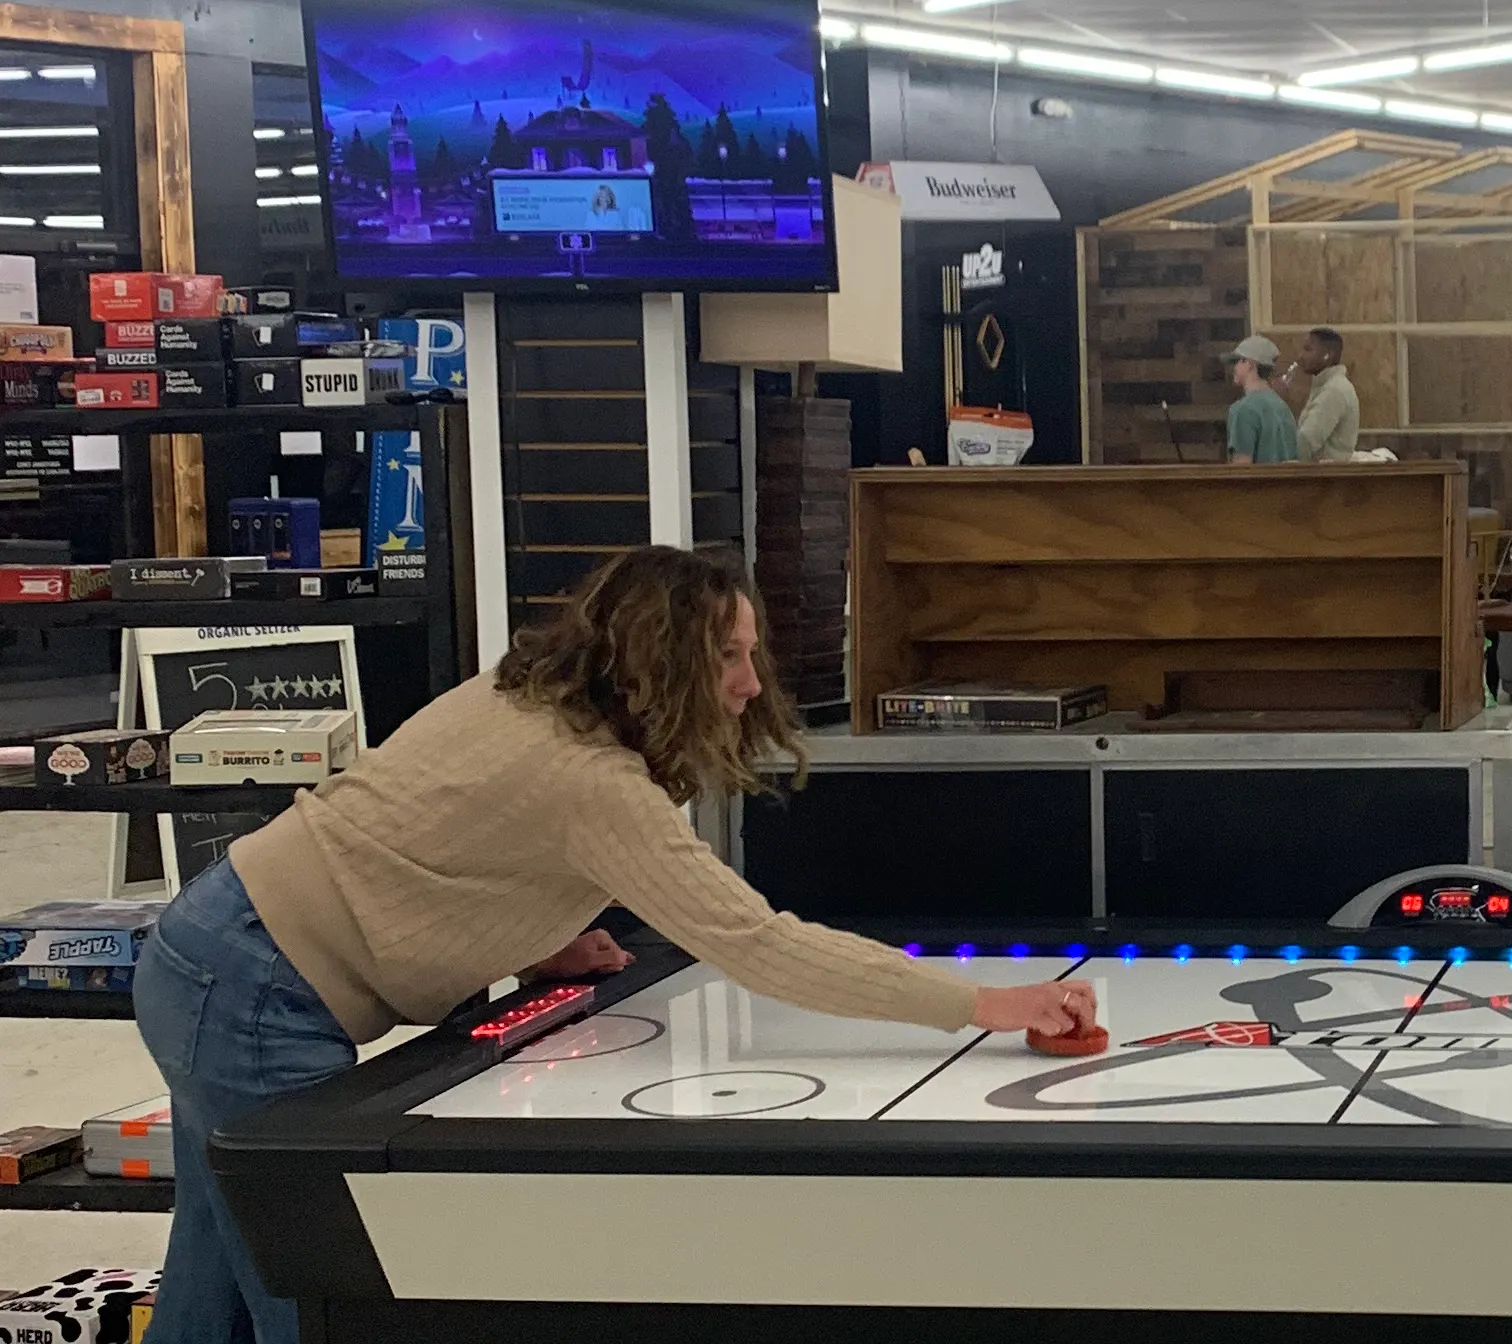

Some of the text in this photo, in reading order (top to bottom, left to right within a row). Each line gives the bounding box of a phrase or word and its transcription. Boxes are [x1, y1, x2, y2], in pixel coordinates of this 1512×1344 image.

[925, 175, 1017, 200] Budweiser
[107, 353, 157, 366] BUZZED
[4, 380, 39, 398] Minds
[304, 373, 359, 394] STUPID
[382, 568, 425, 580] FRIENDS
[197, 626, 251, 640] ORGANIC
[222, 756, 271, 766] BURRITO
[48, 935, 118, 961] TAPPLE
[16, 1328, 53, 1344] HERD
